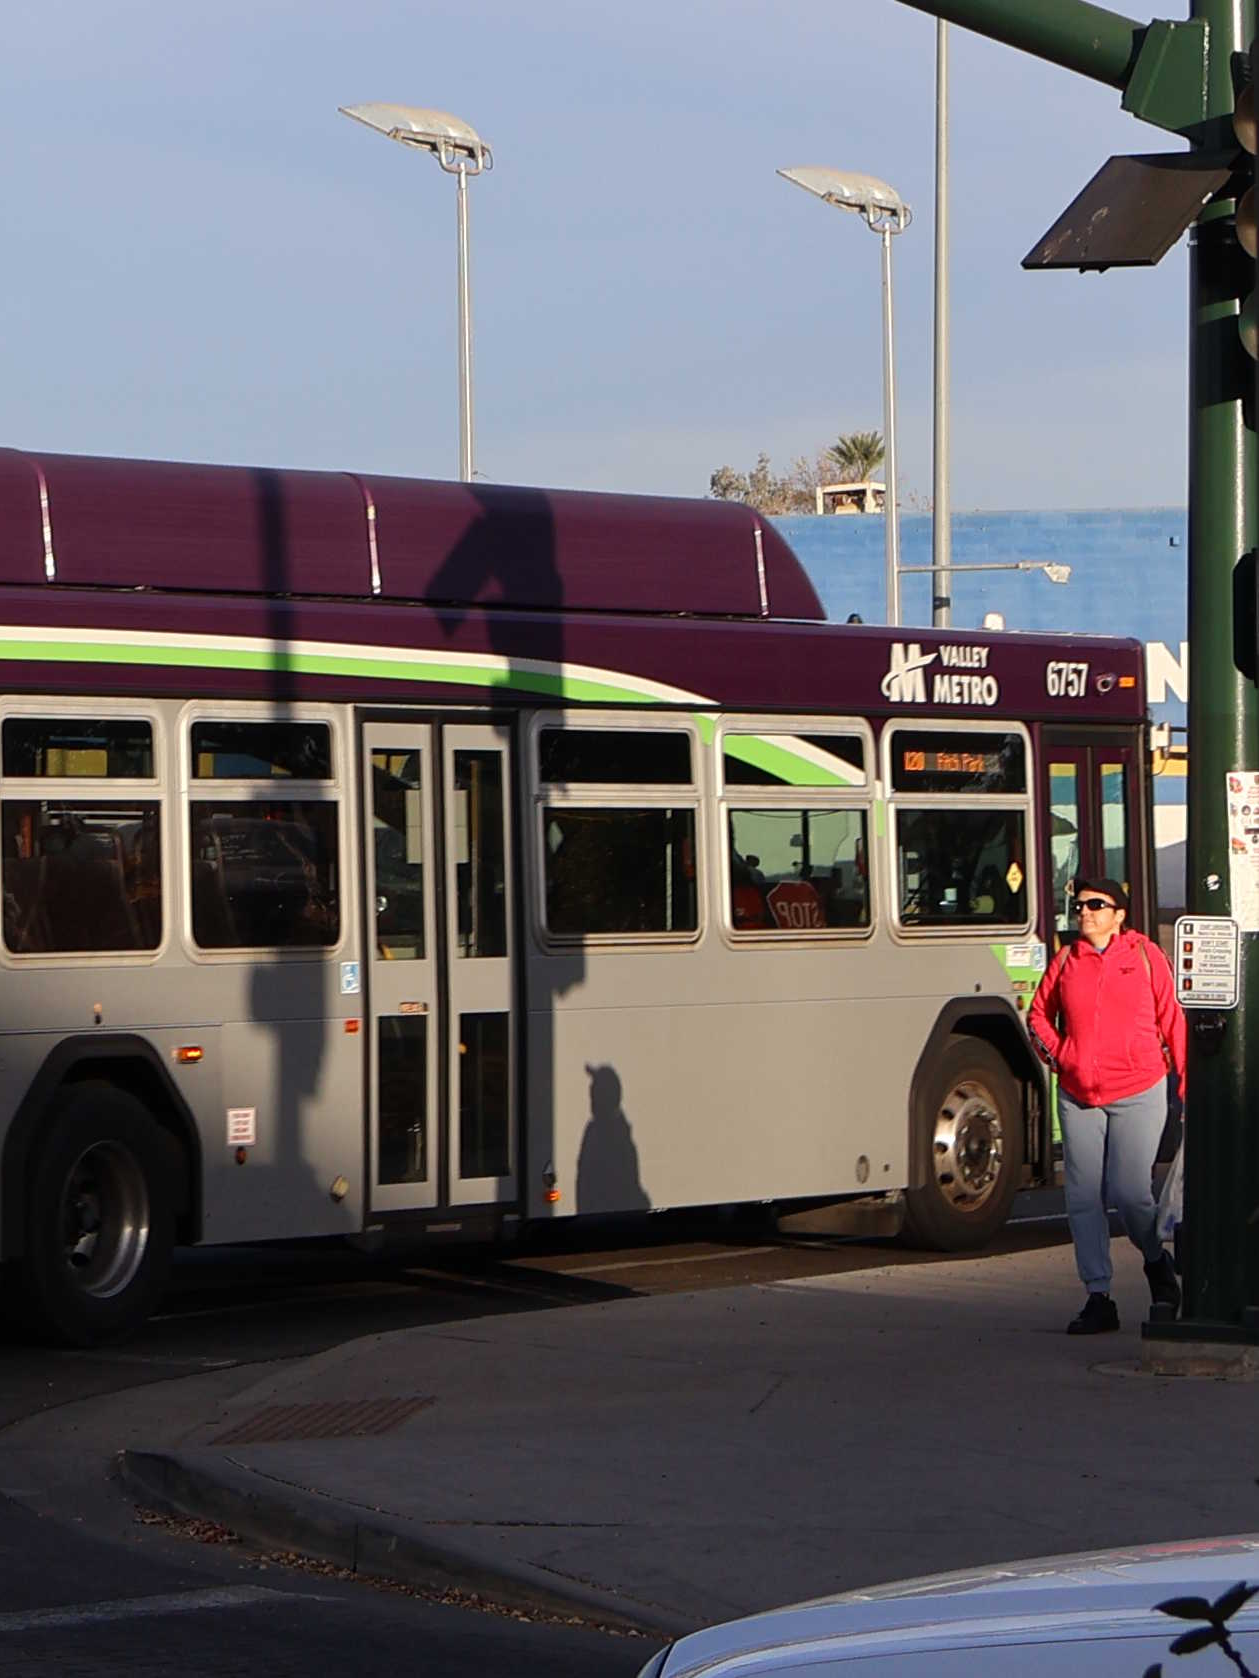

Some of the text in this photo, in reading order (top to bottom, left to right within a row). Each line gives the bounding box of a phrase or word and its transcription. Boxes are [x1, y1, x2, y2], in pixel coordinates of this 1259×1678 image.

[939, 645, 990, 669] VALLEY
[933, 674, 999, 706] METRO
[1046, 660, 1090, 697] 6757
